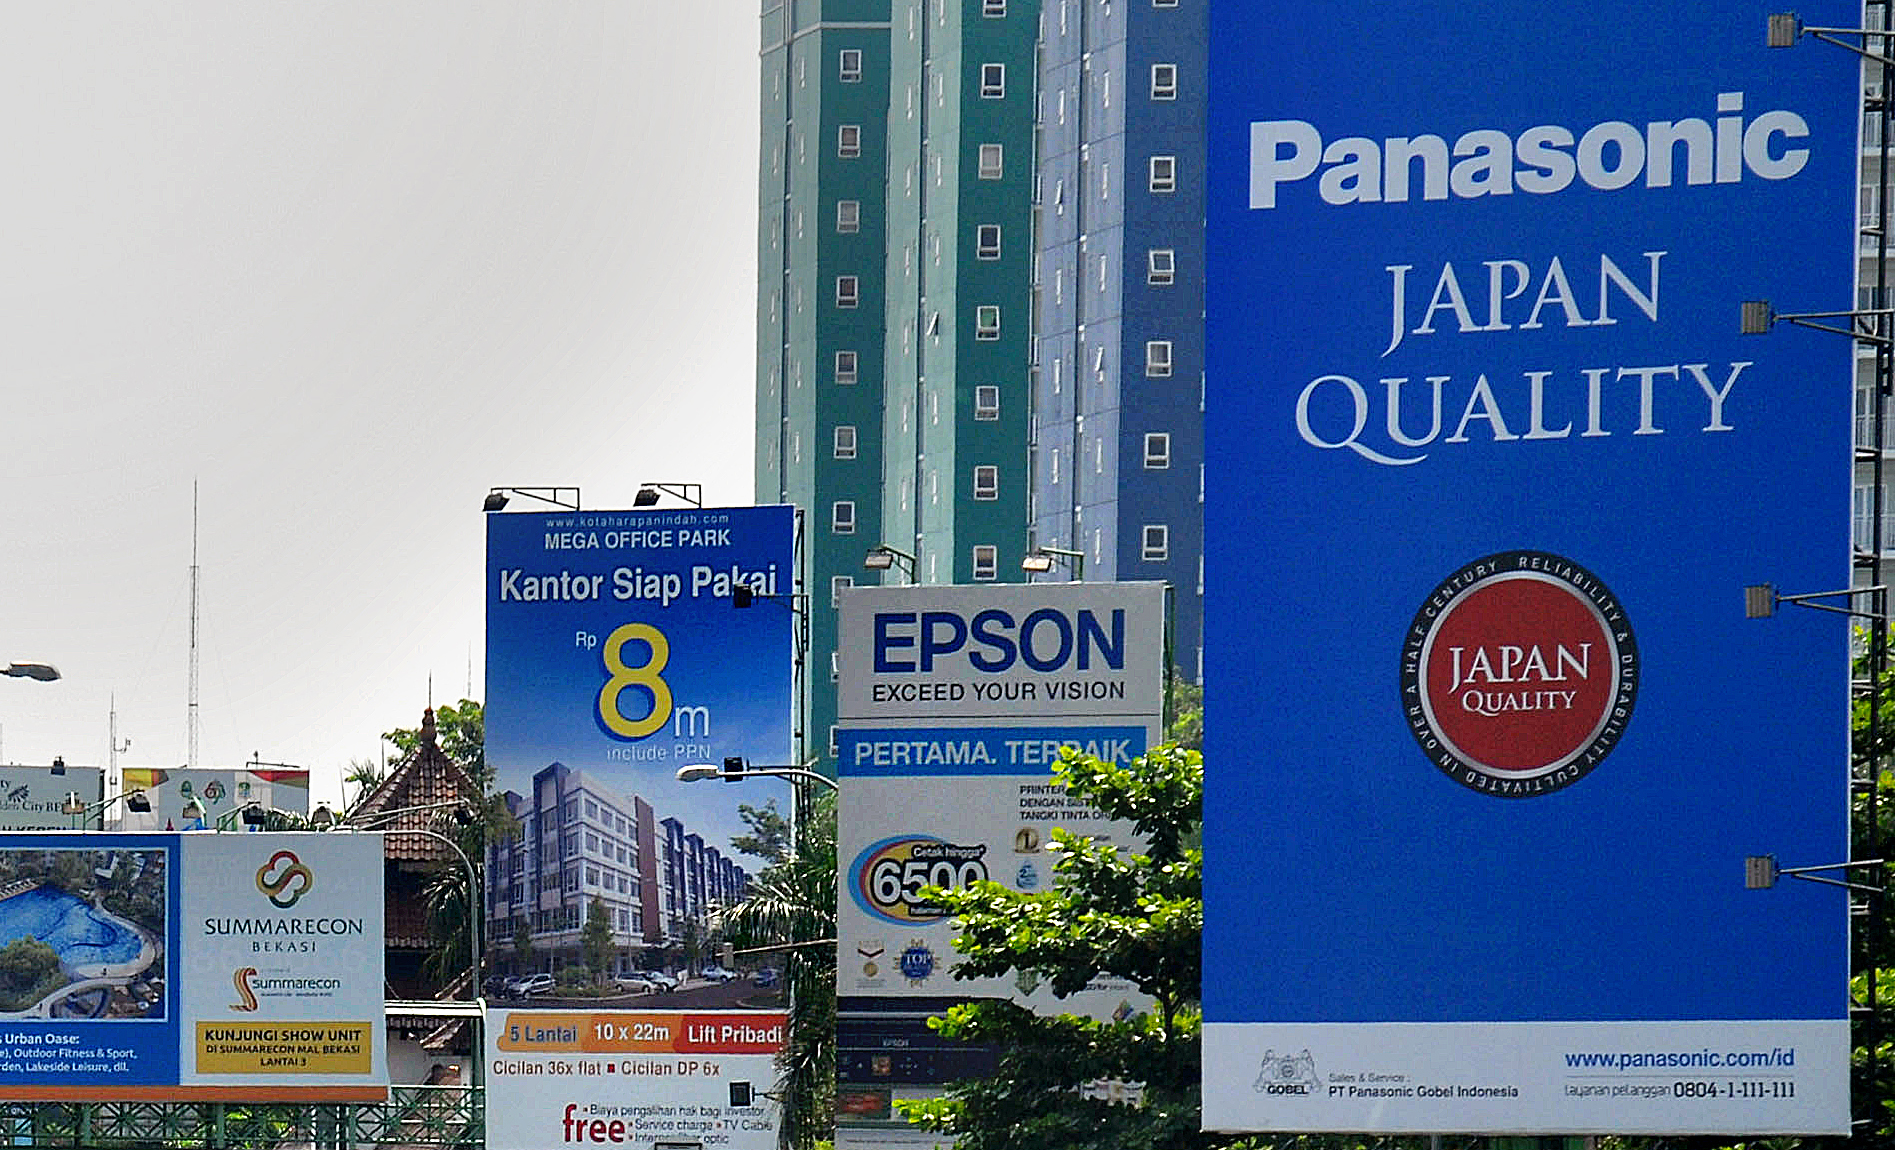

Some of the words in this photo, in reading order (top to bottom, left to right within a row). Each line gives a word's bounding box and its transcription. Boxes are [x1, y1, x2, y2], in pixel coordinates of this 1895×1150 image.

[1249, 92, 1810, 209] Panasonic
[1381, 251, 1667, 358] JAPAN
[1295, 361, 1753, 466] QUALITY
[546, 514, 728, 527] www.kotaharapanindah.com
[545, 532, 599, 550] MEGA
[605, 531, 673, 548] OFFICE
[679, 529, 730, 546] PARK
[501, 567, 603, 601] Kantor
[613, 567, 680, 606] Siap
[692, 565, 775, 598] Pakai
[1427, 561, 1497, 617] CENTURY
[1518, 556, 1621, 623] RELIABILITY
[874, 609, 1124, 673] EPSON
[1407, 625, 1428, 673] HALF
[1448, 643, 1591, 694] JAPAN
[576, 632, 596, 649] Rp
[598, 623, 673, 738] 8
[675, 706, 710, 737] m
[1407, 685, 1417, 694] A
[873, 684, 964, 701] EXCEED
[973, 683, 1035, 700] YOUR
[1046, 682, 1124, 700] VISION
[1462, 691, 1576, 717] QUALITY
[1587, 653, 1633, 765] DURABILITY
[1410, 706, 1436, 749] OVER
[855, 742, 996, 765] PERTAMA.
[1439, 757, 1458, 771] IN
[1467, 764, 1579, 793] CULTIVATED
[205, 918, 363, 935] SUMMARECON
[252, 941, 316, 952] BEKASI
[252, 978, 340, 989] summarecon
[5, 1033, 42, 1044] Urban
[45, 1034, 80, 1044] Oase:
[206, 1030, 278, 1041] KUNJUNGI
[282, 1030, 324, 1041] SHOW
[328, 1030, 362, 1041] UNIT
[511, 1026, 518, 1042] 5
[526, 1026, 577, 1042] Lantai
[595, 1024, 613, 1040] 10
[619, 1028, 628, 1040] x
[634, 1024, 669, 1041] 22m
[689, 1025, 716, 1043] Lift
[722, 1023, 782, 1044] Pribadi
[219, 1045, 294, 1053] SUMMARECON
[323, 1045, 360, 1054] BEKASI
[1564, 1047, 1795, 1069] www.panasonic.com/id
[494, 1061, 543, 1075] Cicilan
[548, 1062, 572, 1075] 36x
[578, 1061, 601, 1075] flat
[622, 1061, 671, 1075] Cicilan
[678, 1062, 699, 1075] DP
[703, 1062, 719, 1076] 6x
[1268, 1085, 1309, 1095] GOBEL
[1329, 1088, 1344, 1097] PT
[1349, 1087, 1413, 1097] Panasonic
[1417, 1087, 1454, 1097] Gobel
[1458, 1086, 1519, 1097] Indonesia
[1673, 1080, 1796, 1099] 0804-1-111-111
[563, 1104, 625, 1143] free
